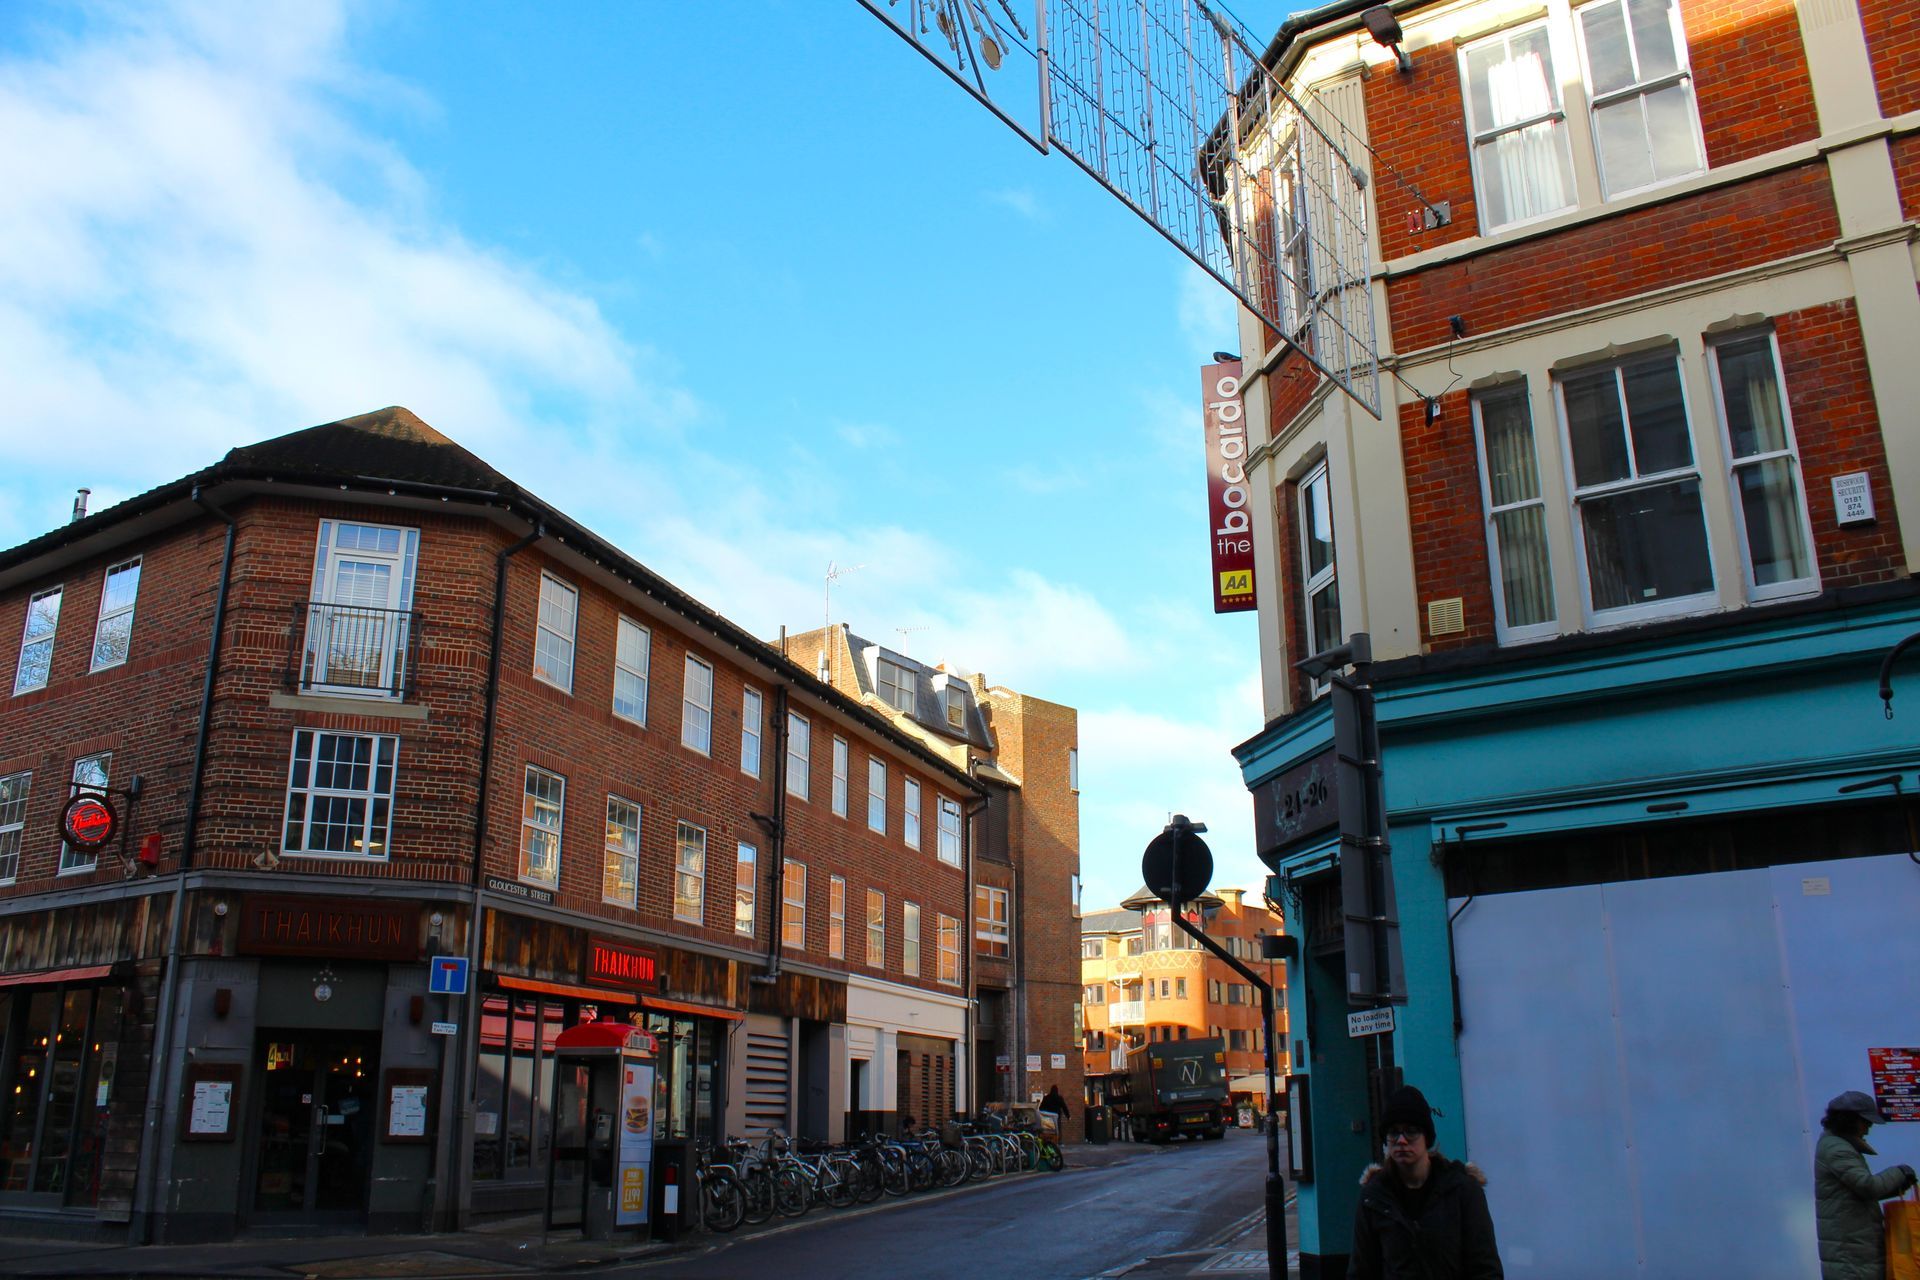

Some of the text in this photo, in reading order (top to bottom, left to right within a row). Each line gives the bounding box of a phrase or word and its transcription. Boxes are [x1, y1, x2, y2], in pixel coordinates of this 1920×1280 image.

[1209, 375, 1251, 555] the bocardo
[1838, 485, 1865, 496] SECURITY
[1844, 496, 1862, 504] 0181
[1847, 509, 1865, 517] 4449
[1224, 574, 1248, 590] AA
[489, 879, 552, 902] GLOUCESTER STREET
[257, 909, 404, 945] THAIKHUN
[593, 946, 656, 982] THAIKHUN
[1351, 1012, 1390, 1024] No loading
[1351, 1021, 1391, 1033] at any time
